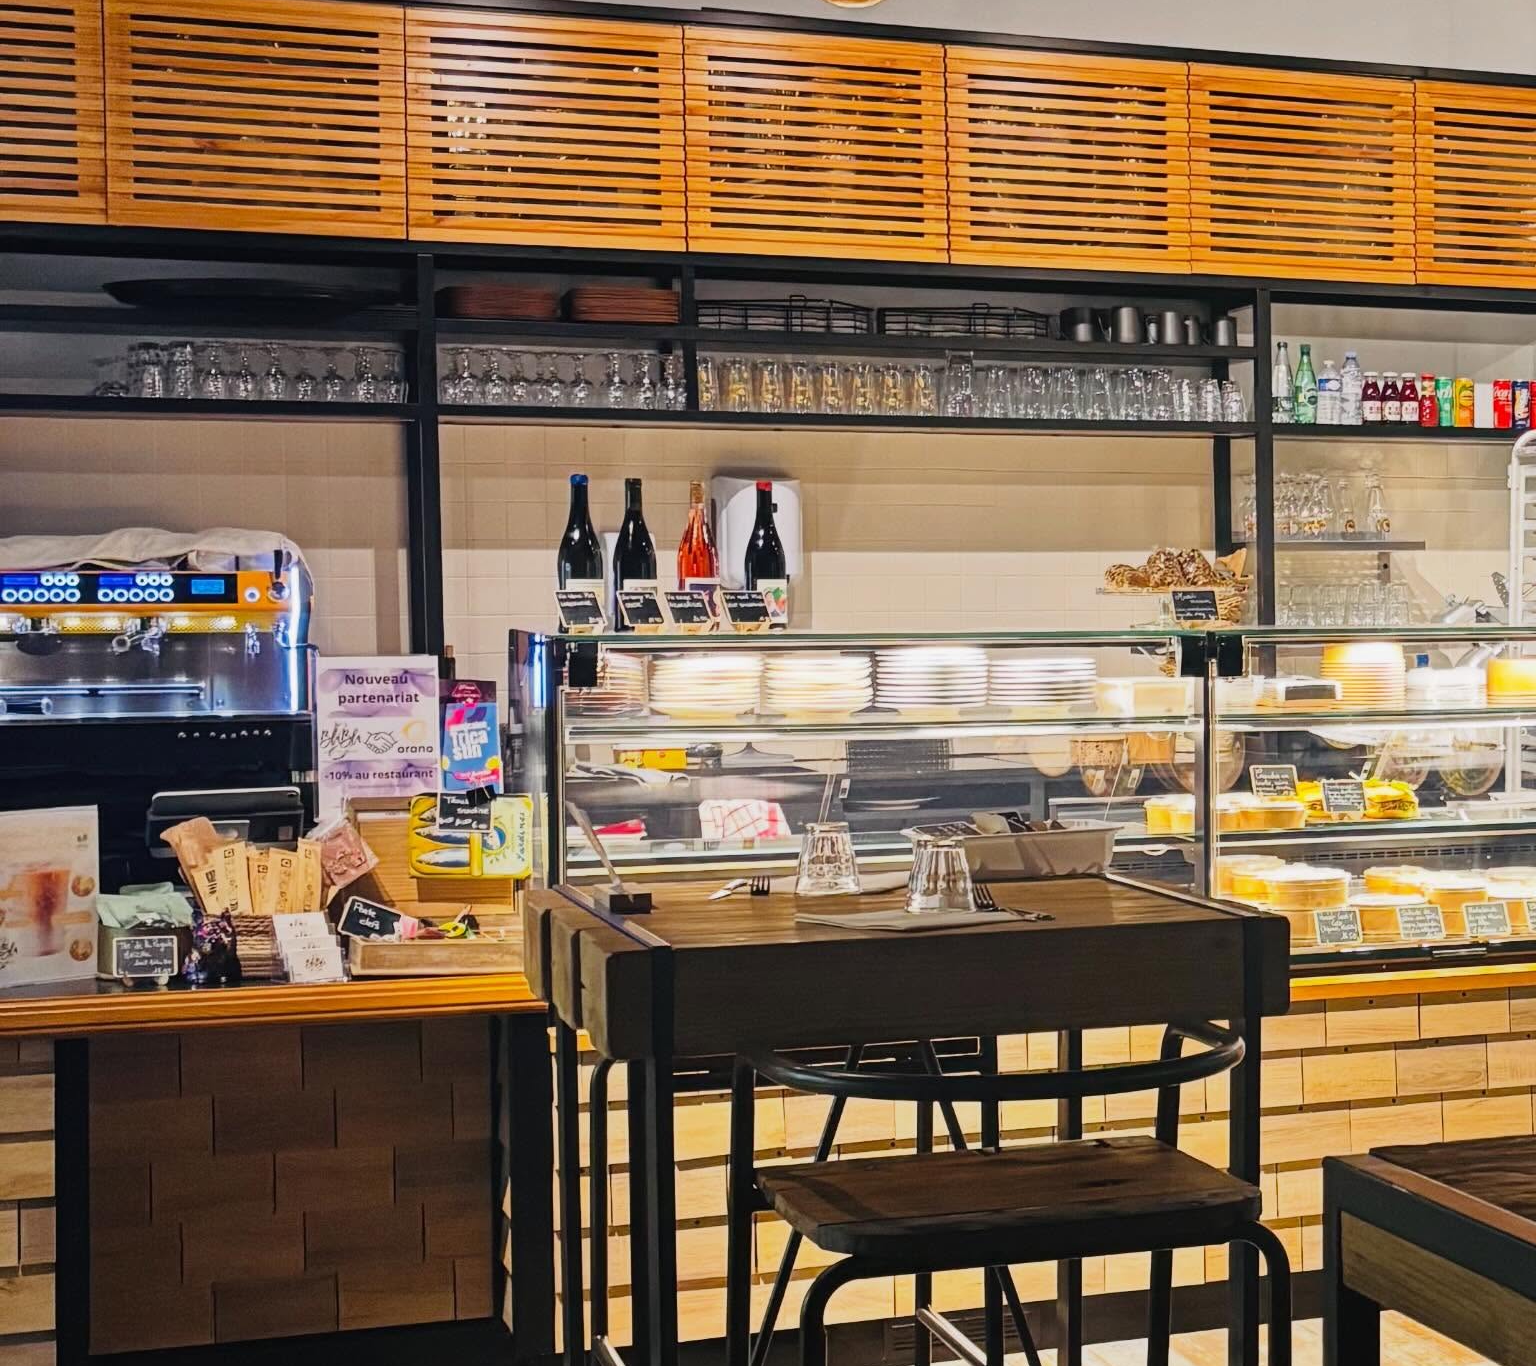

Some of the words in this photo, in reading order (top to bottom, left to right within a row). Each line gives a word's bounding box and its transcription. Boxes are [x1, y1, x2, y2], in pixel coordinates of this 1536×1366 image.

[345, 674, 409, 685] Nouveau
[338, 693, 420, 706] partenariat
[324, 771, 353, 780] -10%
[355, 772, 370, 780] au
[373, 770, 434, 779] restaurant
